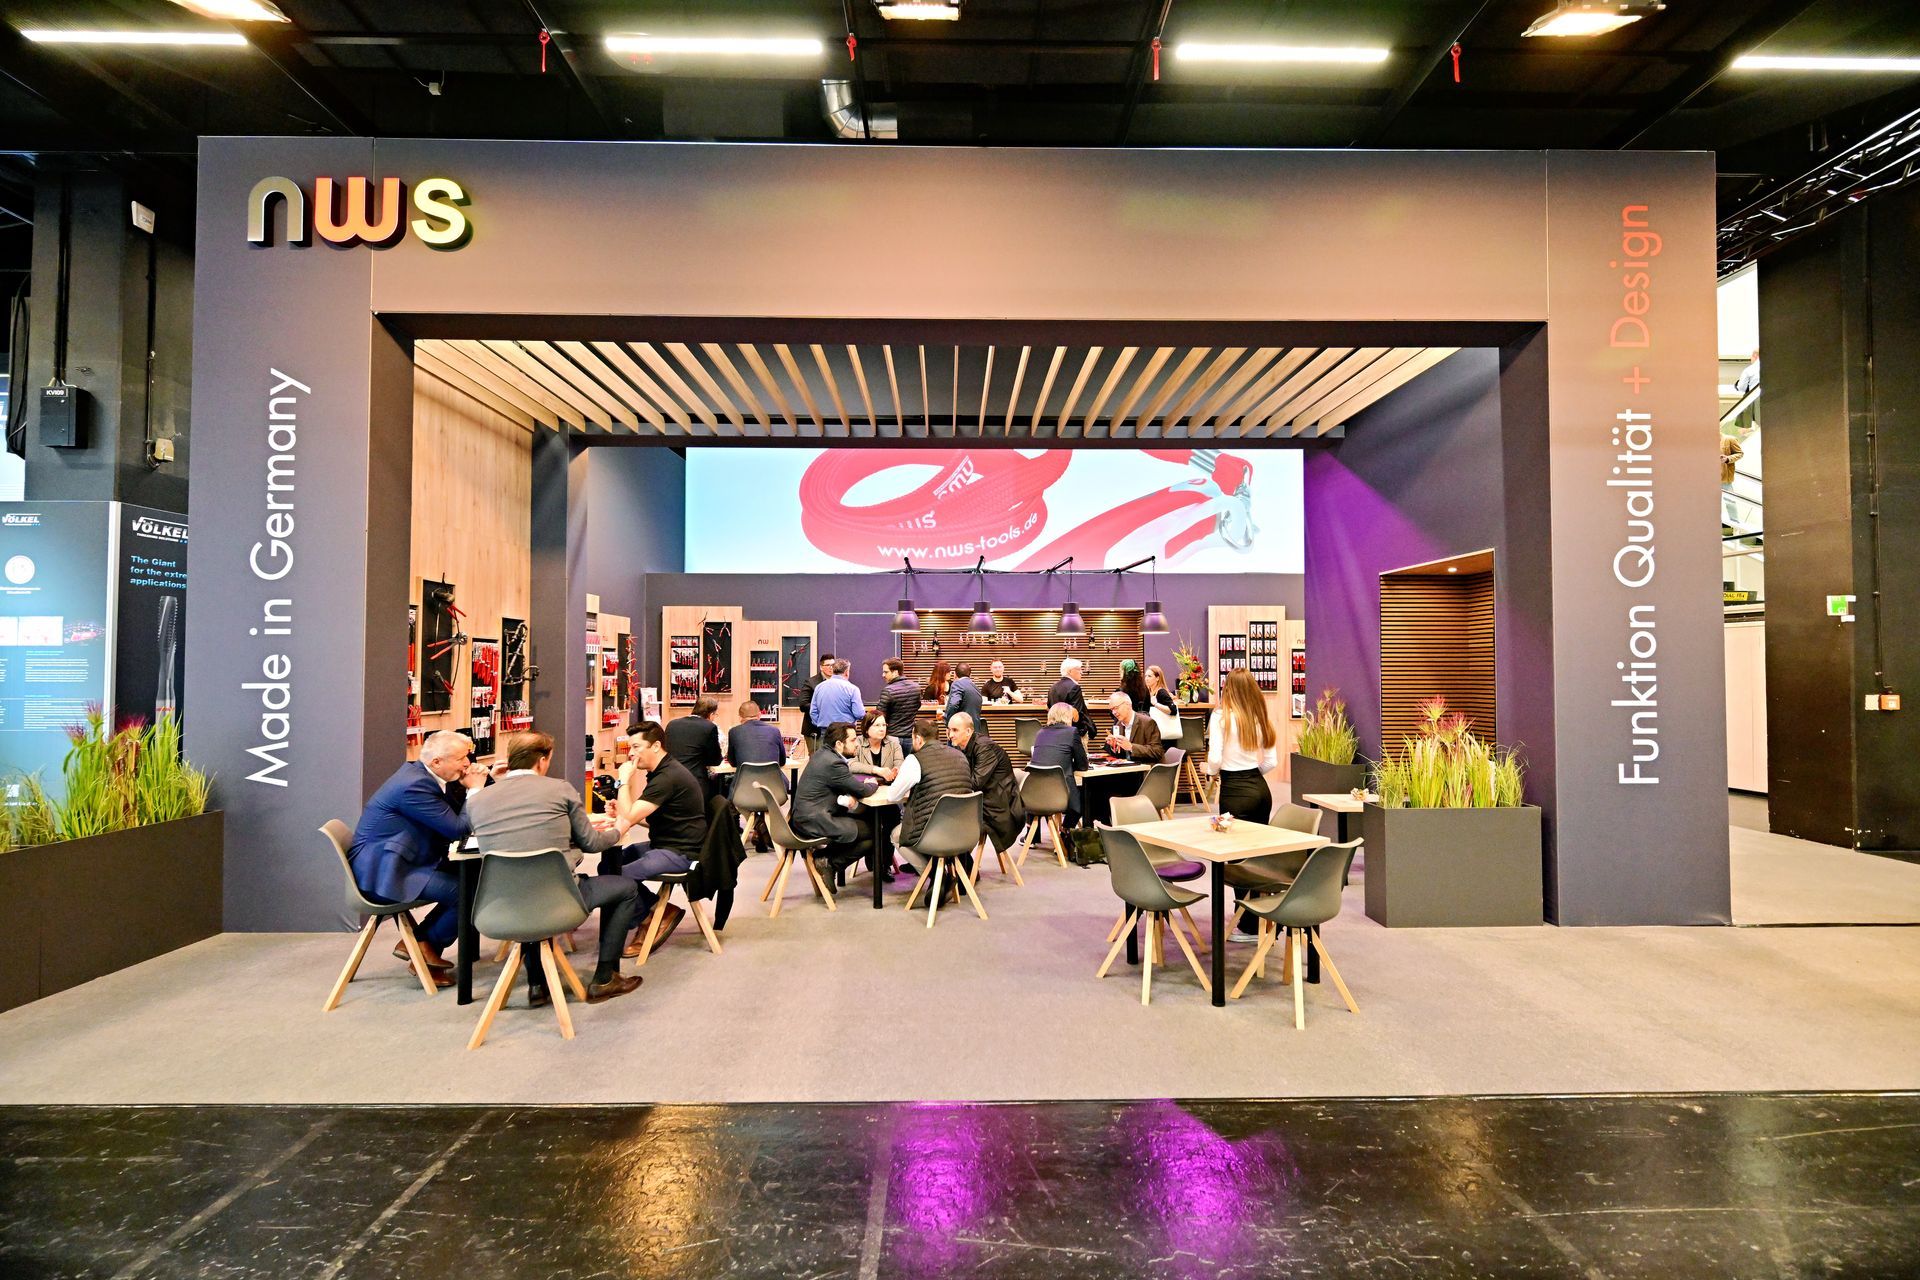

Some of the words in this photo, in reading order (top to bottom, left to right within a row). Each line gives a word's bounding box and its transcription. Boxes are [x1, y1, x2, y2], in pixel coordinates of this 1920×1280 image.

[247, 175, 469, 248] nws
[1609, 204, 1664, 346] Design
[1625, 367, 1650, 392] +
[249, 367, 311, 581] Germany
[1, 513, 41, 524] VÖLKEL
[1606, 407, 1656, 588] Qualität
[131, 516, 189, 540] VÖLKEL
[876, 512, 1038, 559] www.nws-tools.de
[130, 555, 148, 564] The
[151, 559, 176, 567] Giant
[130, 566, 145, 574] for
[146, 568, 161, 577] the
[130, 578, 187, 589] applications
[249, 599, 293, 636] in
[1611, 605, 1660, 785] Funktion
[241, 654, 291, 788] Made
